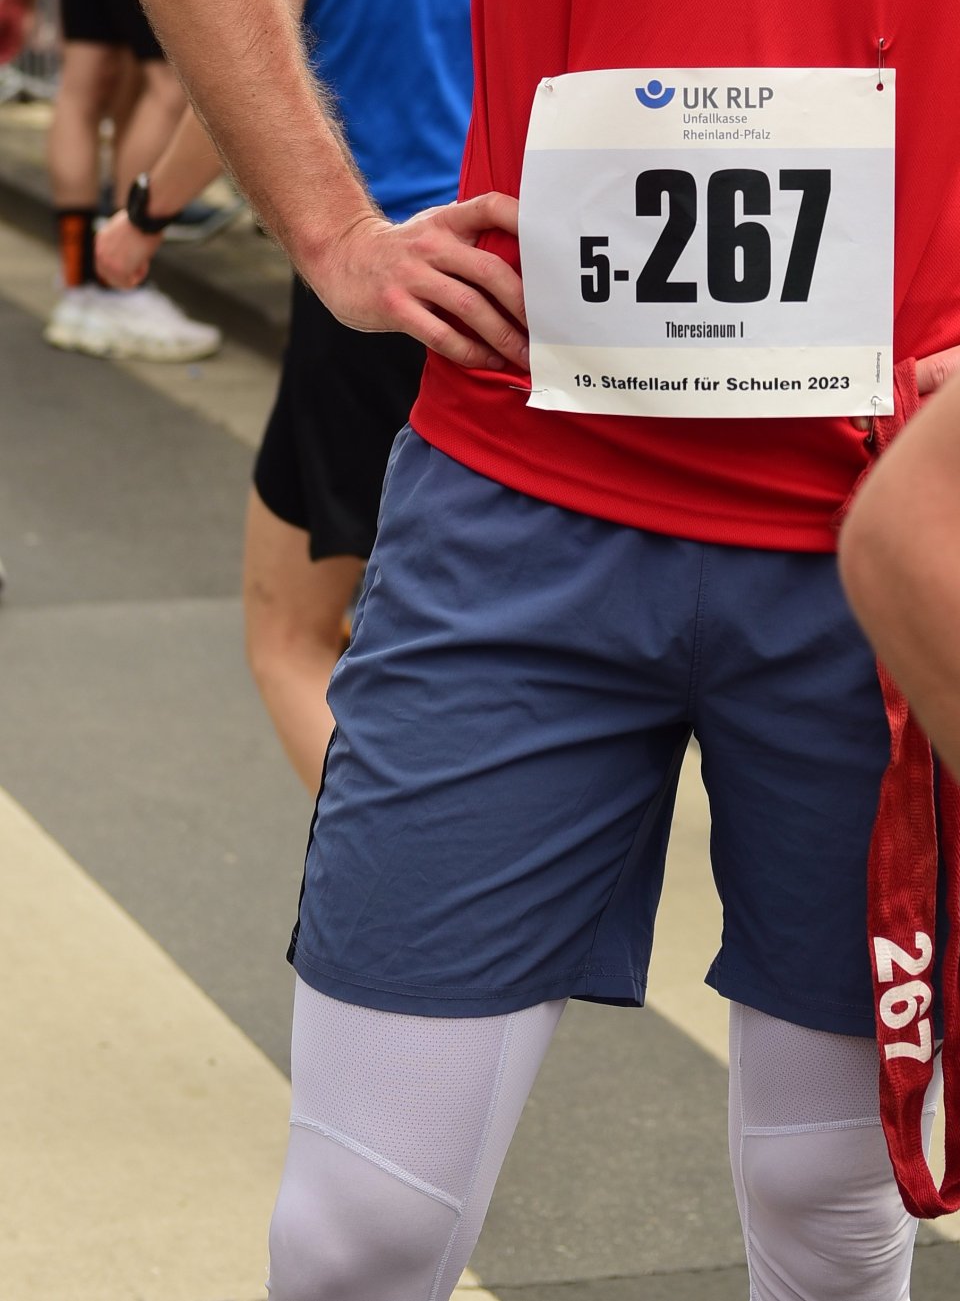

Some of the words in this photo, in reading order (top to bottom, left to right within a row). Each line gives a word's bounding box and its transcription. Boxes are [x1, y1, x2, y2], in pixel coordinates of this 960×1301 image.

[683, 87, 718, 109] UK
[727, 87, 774, 109] RLP
[683, 113, 748, 124] Unfallkasse
[683, 129, 771, 140] Rheinland-Pfalz
[580, 168, 832, 304] 5-267
[665, 321, 736, 339] Theresianum
[574, 374, 597, 388] 19.
[601, 375, 688, 391] Staffellauf
[694, 376, 720, 391] für
[726, 377, 801, 391] Schulen
[808, 376, 850, 390] 2023
[873, 931, 934, 1064] 267
